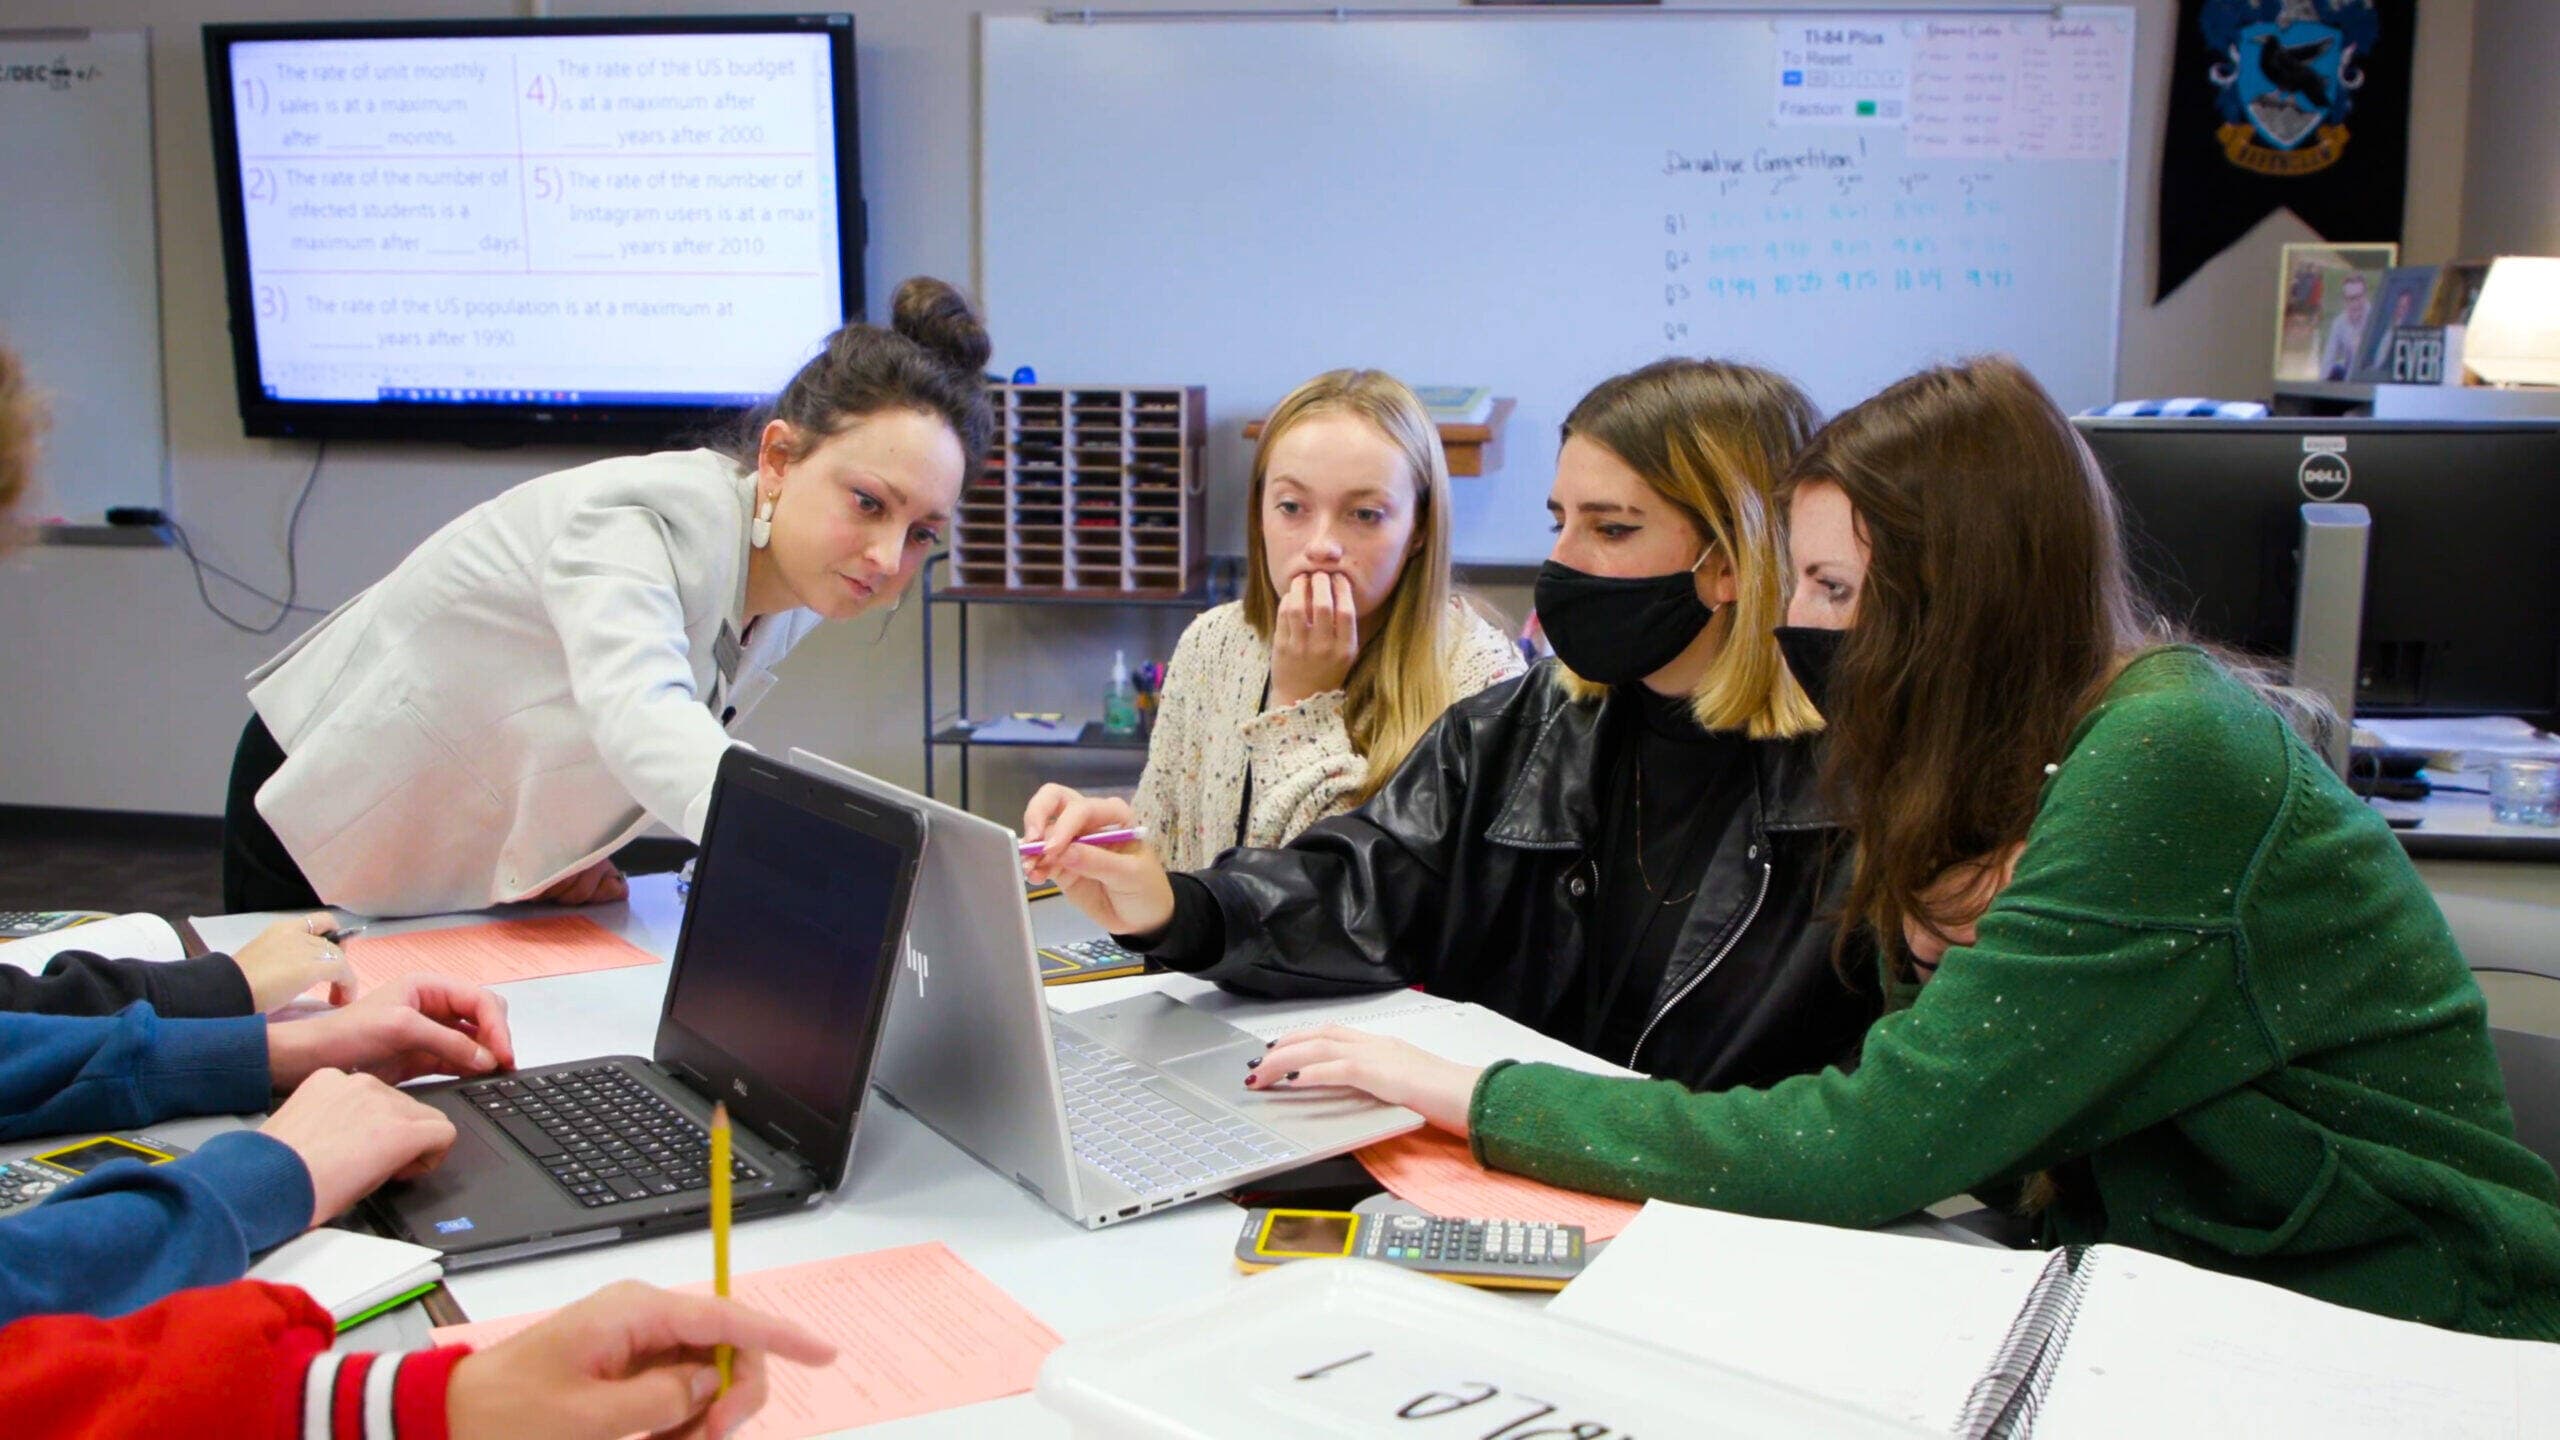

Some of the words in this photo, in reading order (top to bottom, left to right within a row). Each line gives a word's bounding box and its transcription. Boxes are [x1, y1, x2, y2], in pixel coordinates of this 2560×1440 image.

[1848, 29, 1884, 45] Plus
[277, 63, 307, 80] The
[314, 66, 345, 80] rate
[352, 62, 370, 80] of
[374, 65, 408, 80] unit
[413, 61, 488, 84] monthly
[558, 59, 590, 77] The
[596, 62, 631, 77] rate
[638, 58, 655, 77] of
[660, 59, 690, 77] the
[697, 58, 722, 77] US
[728, 57, 796, 82] budget
[526, 74, 557, 113] 4)
[560, 97, 574, 112] is
[580, 96, 595, 112] at
[602, 98, 613, 112] a
[618, 96, 710, 112] maximum
[715, 92, 757, 111] after
[280, 99, 319, 114] sales
[326, 98, 339, 113] is
[345, 99, 360, 113] at
[367, 99, 376, 113] a
[380, 98, 468, 114] maximum
[282, 128, 320, 146] after
[617, 129, 667, 149] years
[671, 126, 713, 145] after
[248, 167, 279, 206] 2)
[287, 169, 317, 186] The
[322, 171, 354, 186] rate
[360, 167, 378, 186] of
[383, 169, 412, 186] the
[417, 167, 484, 187] number
[491, 168, 509, 187] of
[533, 165, 564, 204] 5)
[569, 170, 601, 189] The
[607, 173, 642, 189] rate
[647, 169, 665, 188] of
[671, 170, 701, 189] the
[706, 169, 778, 189] number
[784, 169, 804, 189] of
[288, 203, 357, 220] infected
[363, 203, 435, 220] students
[442, 203, 454, 219] is
[461, 205, 470, 219] a
[568, 203, 660, 228] Instagram
[666, 207, 713, 223] users
[718, 205, 731, 222] is
[737, 206, 755, 222] at
[761, 207, 772, 222] a
[778, 206, 814, 223] max
[291, 237, 376, 251] maximum
[382, 233, 421, 251] after
[619, 239, 667, 260] years
[672, 236, 713, 256] after
[258, 286, 288, 324] 3)
[306, 296, 337, 314] The
[342, 298, 373, 314] rate
[380, 297, 397, 315] of
[401, 298, 431, 315] the
[435, 297, 460, 315] US
[464, 297, 560, 320] population
[566, 299, 579, 316] is
[584, 299, 600, 316] at
[606, 300, 617, 316] a
[622, 299, 711, 317] maximum
[716, 299, 733, 316] at
[377, 329, 422, 350] years
[427, 327, 467, 347] after
[2393, 339, 2442, 381] EVER
[2304, 469, 2345, 483] DELL
